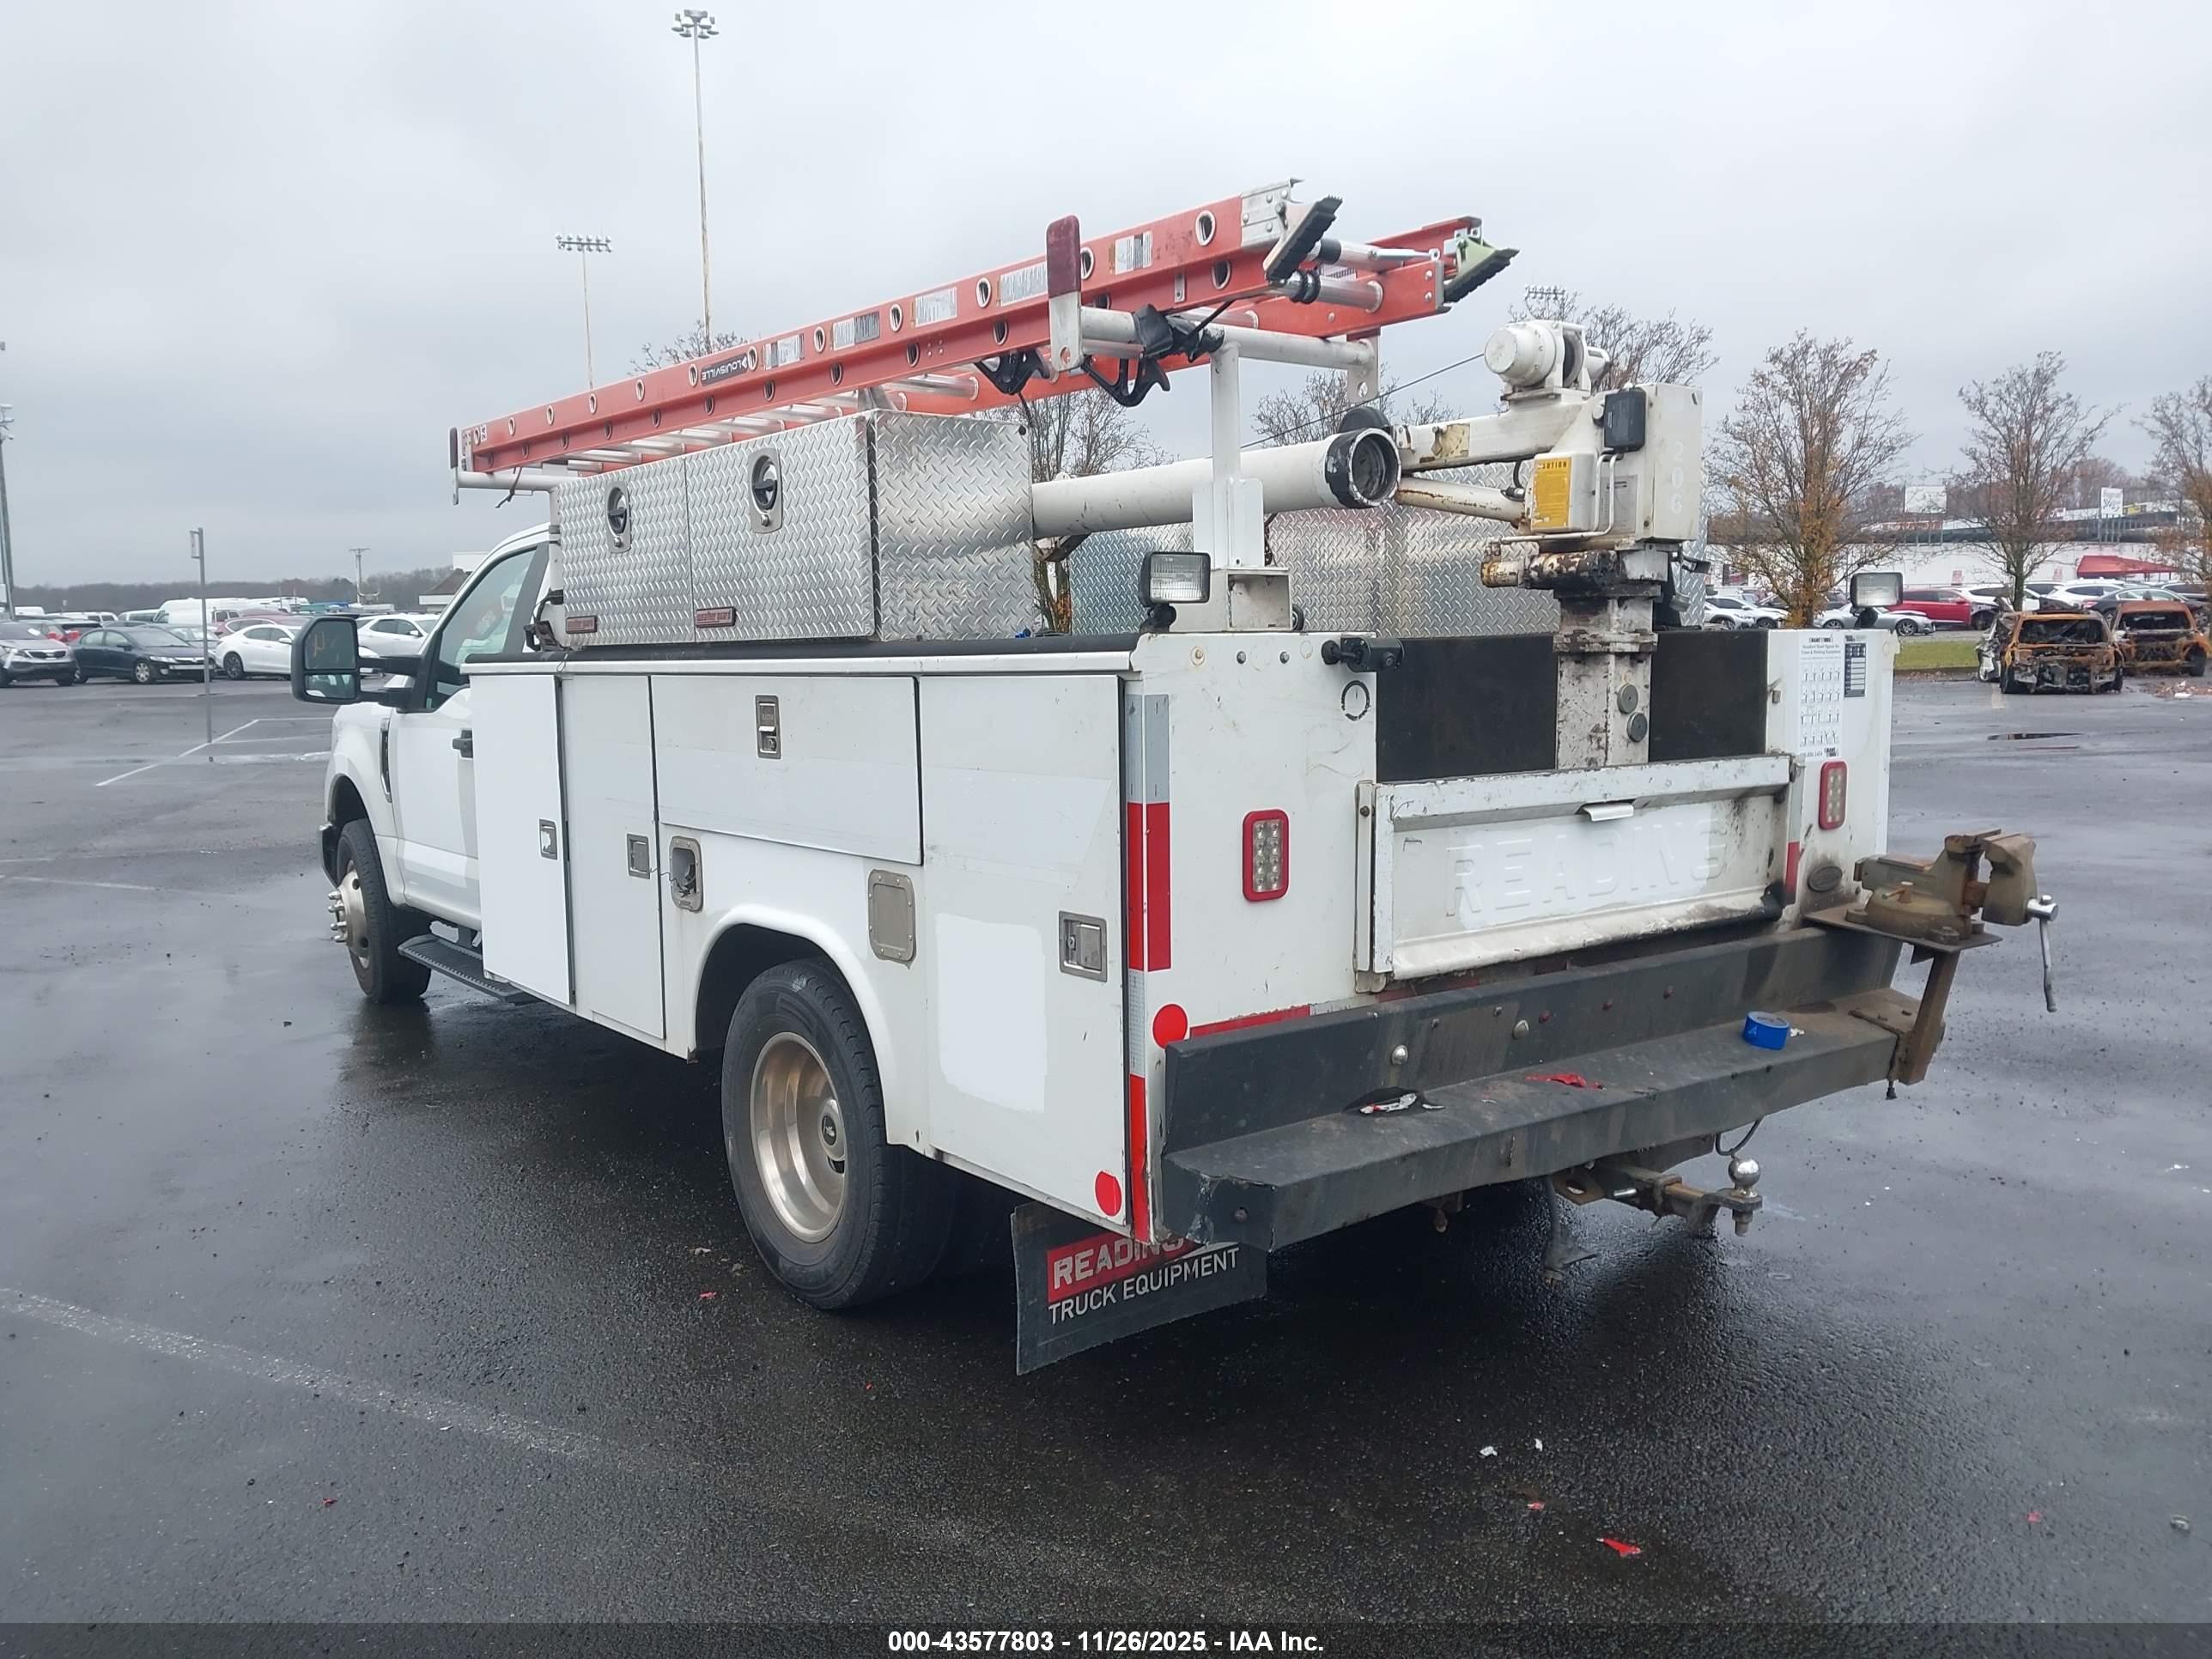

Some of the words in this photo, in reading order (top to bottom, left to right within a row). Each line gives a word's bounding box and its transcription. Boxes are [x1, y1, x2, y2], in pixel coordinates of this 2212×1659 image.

[701, 359, 742, 380] LOUISVILLE
[1538, 460, 1568, 470] AUTION
[1445, 818, 1729, 917] READING
[1048, 1284, 1117, 1325] TRUCK
[1123, 1248, 1240, 1300] EQUIPMENT
